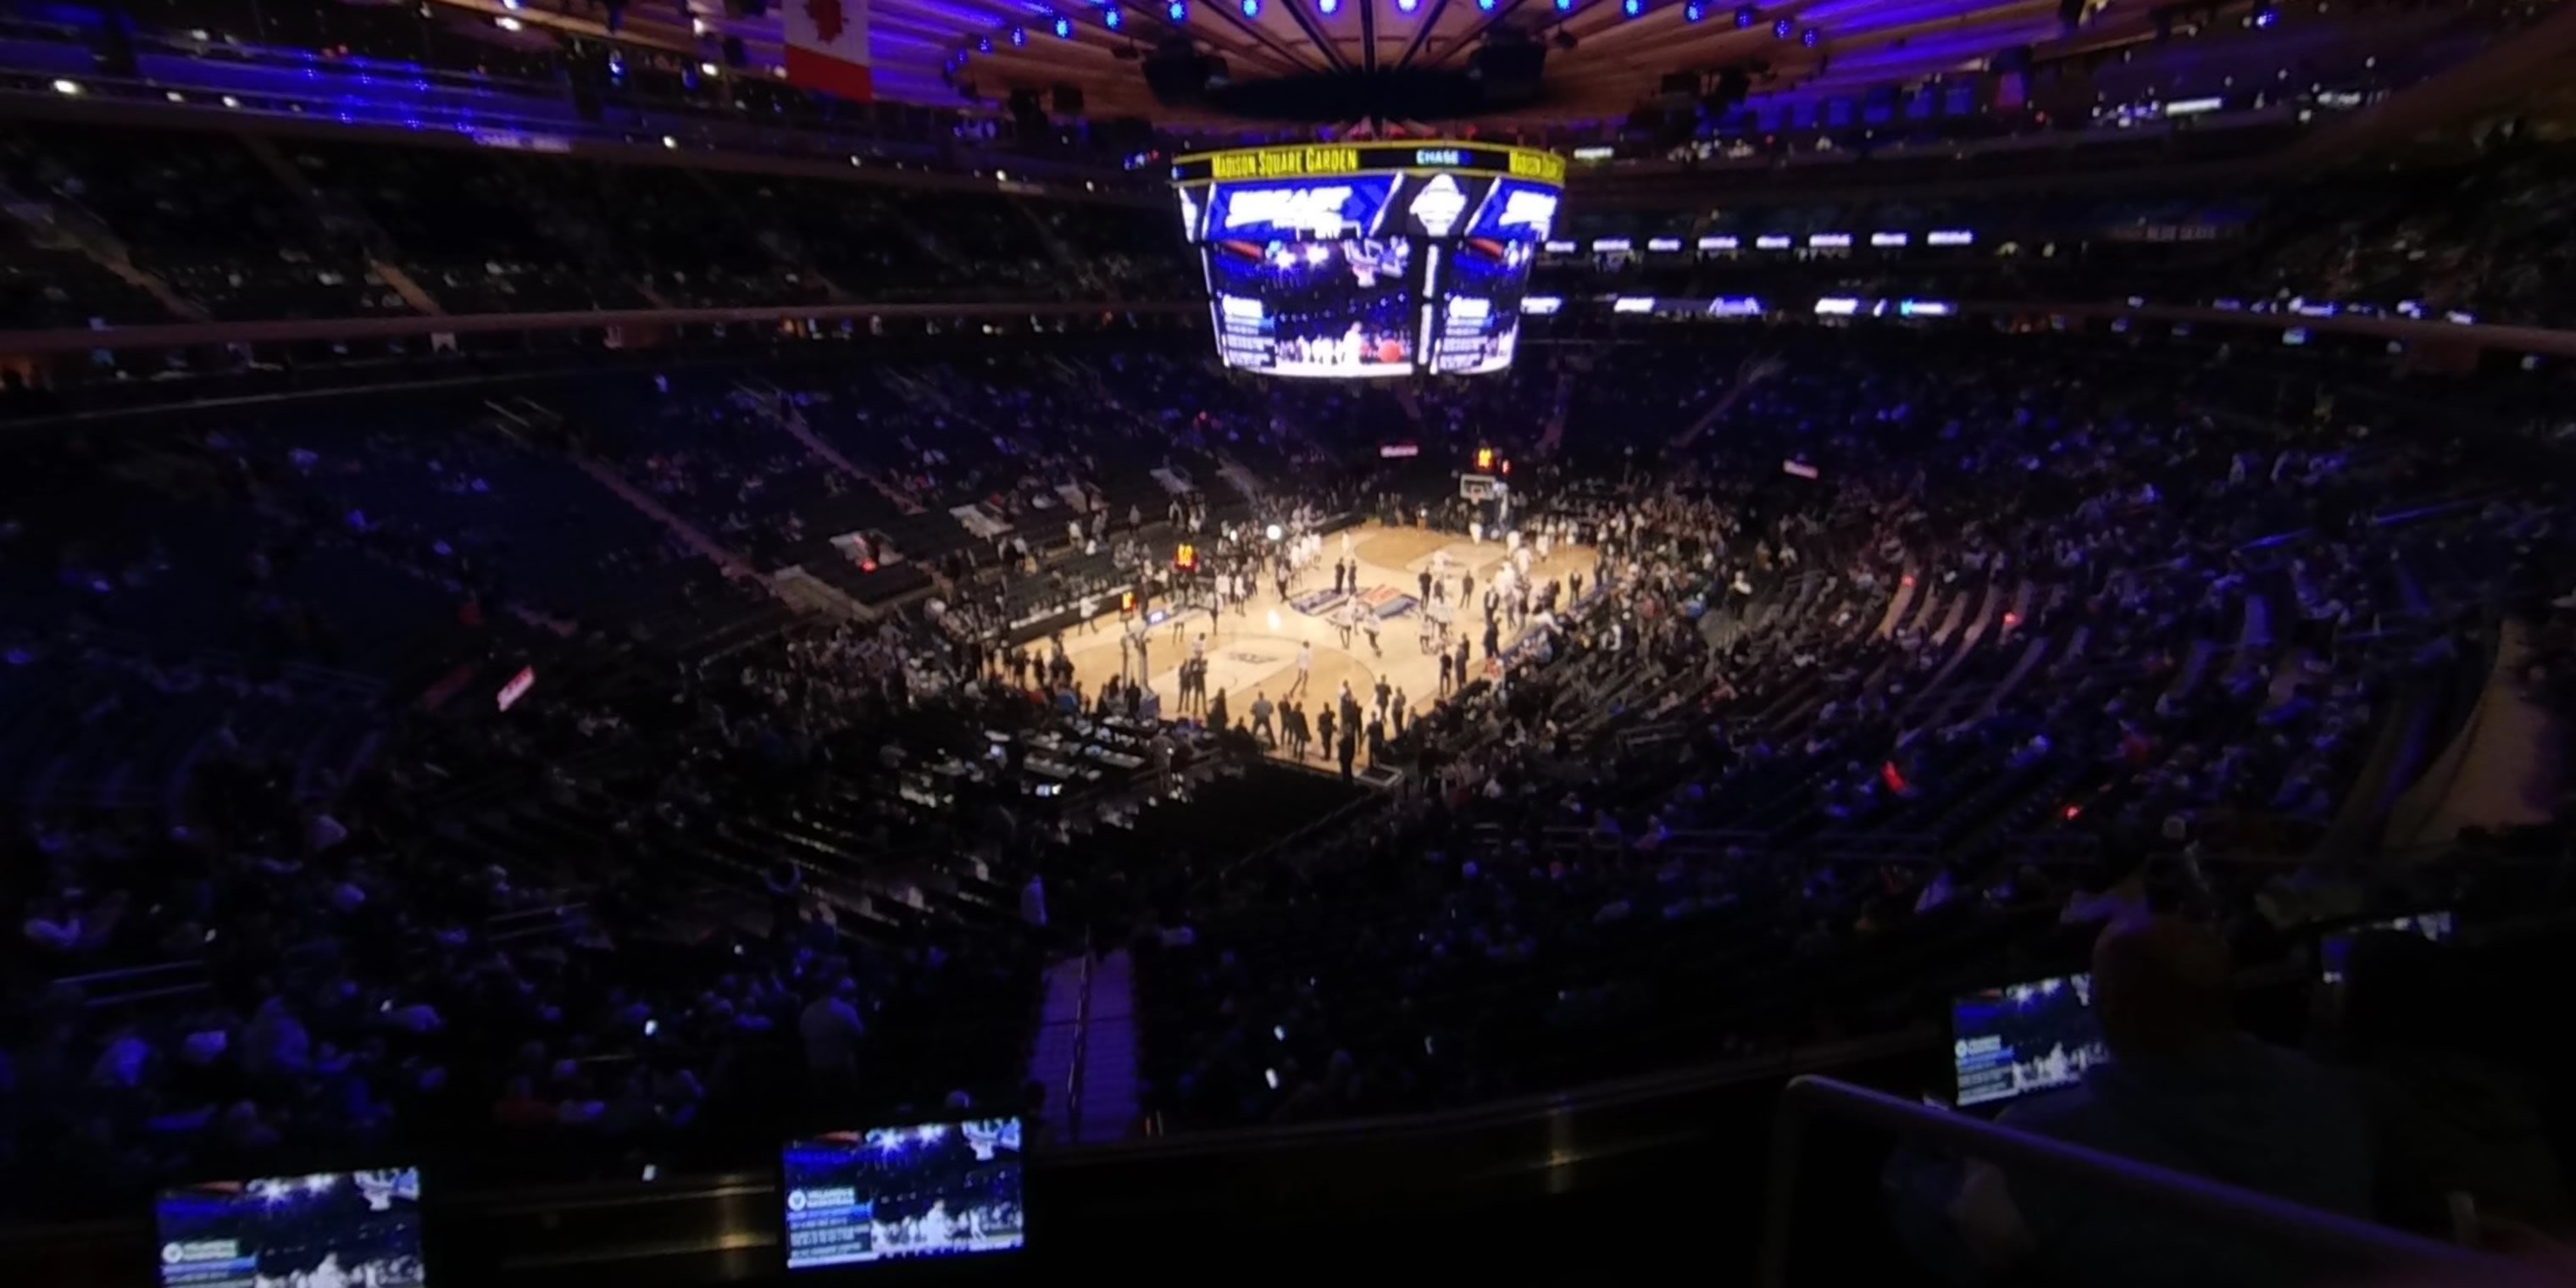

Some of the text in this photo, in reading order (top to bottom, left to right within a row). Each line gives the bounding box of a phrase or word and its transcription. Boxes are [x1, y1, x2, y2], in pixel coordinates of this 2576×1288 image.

[1258, 148, 1302, 175] SQUARE
[1306, 147, 1357, 172] GARDEN
[1416, 149, 1458, 164] CHASE
